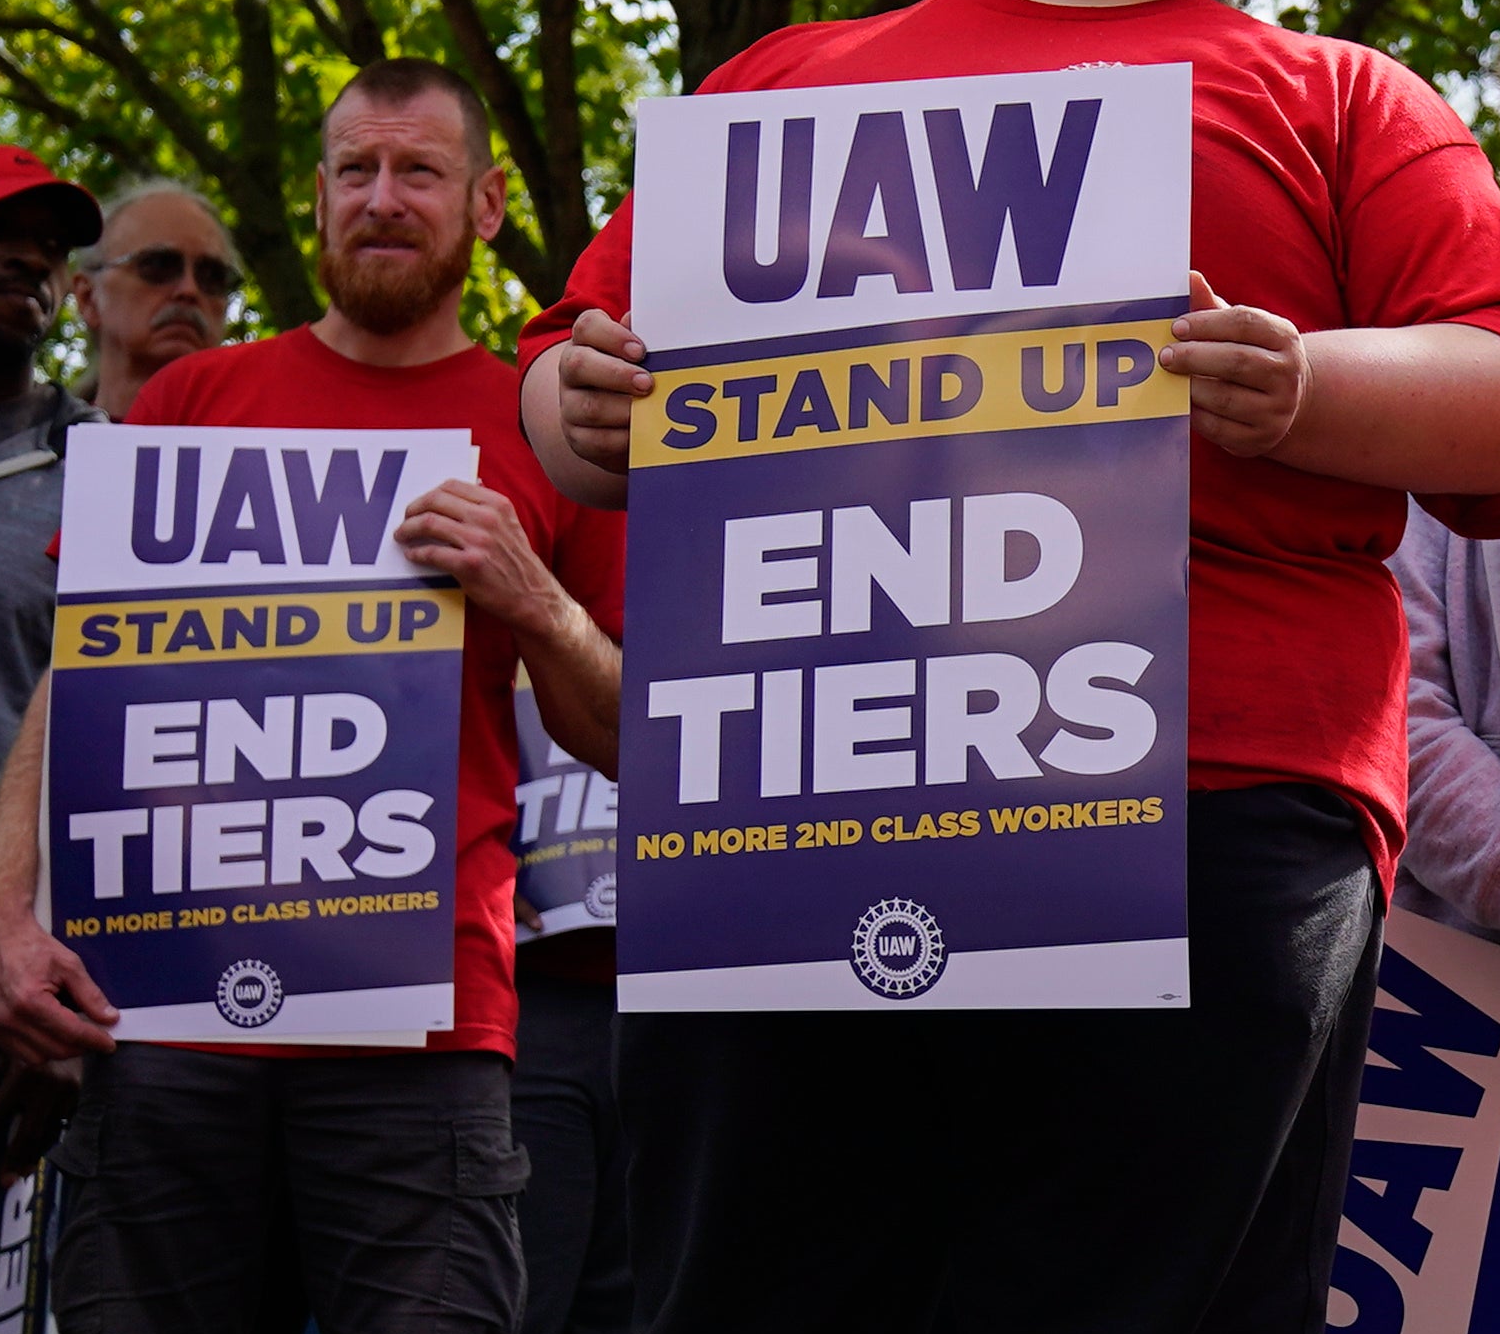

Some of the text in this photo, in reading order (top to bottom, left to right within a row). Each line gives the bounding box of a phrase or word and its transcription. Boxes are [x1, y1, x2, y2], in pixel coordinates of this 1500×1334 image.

[721, 98, 1102, 304] UAW
[661, 338, 1158, 450] STAND UP
[131, 446, 408, 565] UAW
[721, 491, 1083, 645] END
[79, 601, 440, 658] STAND UP
[122, 693, 386, 790] END
[648, 640, 1159, 805] TIERS
[69, 789, 435, 900] TIERS
[515, 770, 619, 844] TIE
[636, 834, 685, 860] NO
[693, 824, 788, 856] MORE
[795, 819, 862, 850] 2ND
[871, 810, 981, 843] CLASS
[988, 796, 1164, 835] WORKERS
[66, 891, 439, 938] NO MORE 2ND CLASS WORKERS
[879, 935, 916, 958] UAW
[235, 983, 263, 1001] UAW
